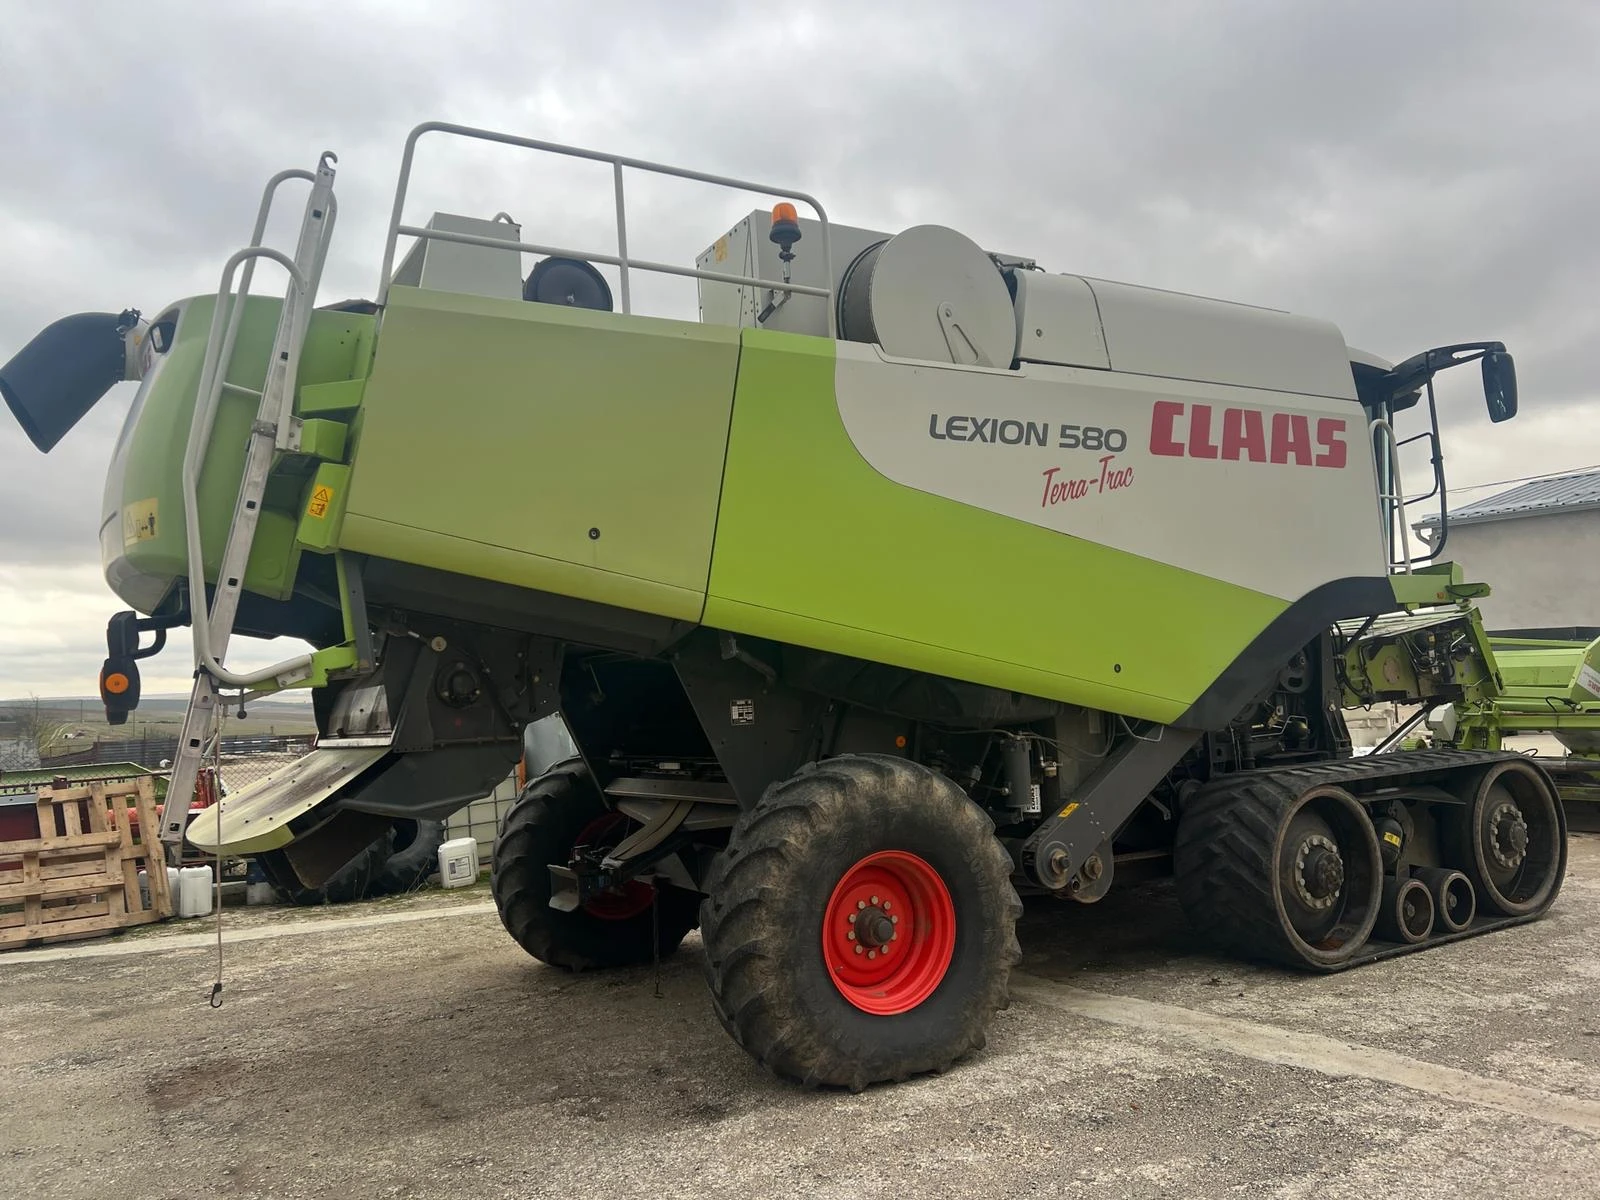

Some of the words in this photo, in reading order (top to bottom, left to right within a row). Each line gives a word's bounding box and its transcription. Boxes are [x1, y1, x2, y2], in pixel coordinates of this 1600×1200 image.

[929, 413, 1049, 447] LEXION
[1058, 424, 1127, 452] 580
[1149, 400, 1347, 469] CLAAS
[1042, 455, 1134, 507] Terra-Trac
